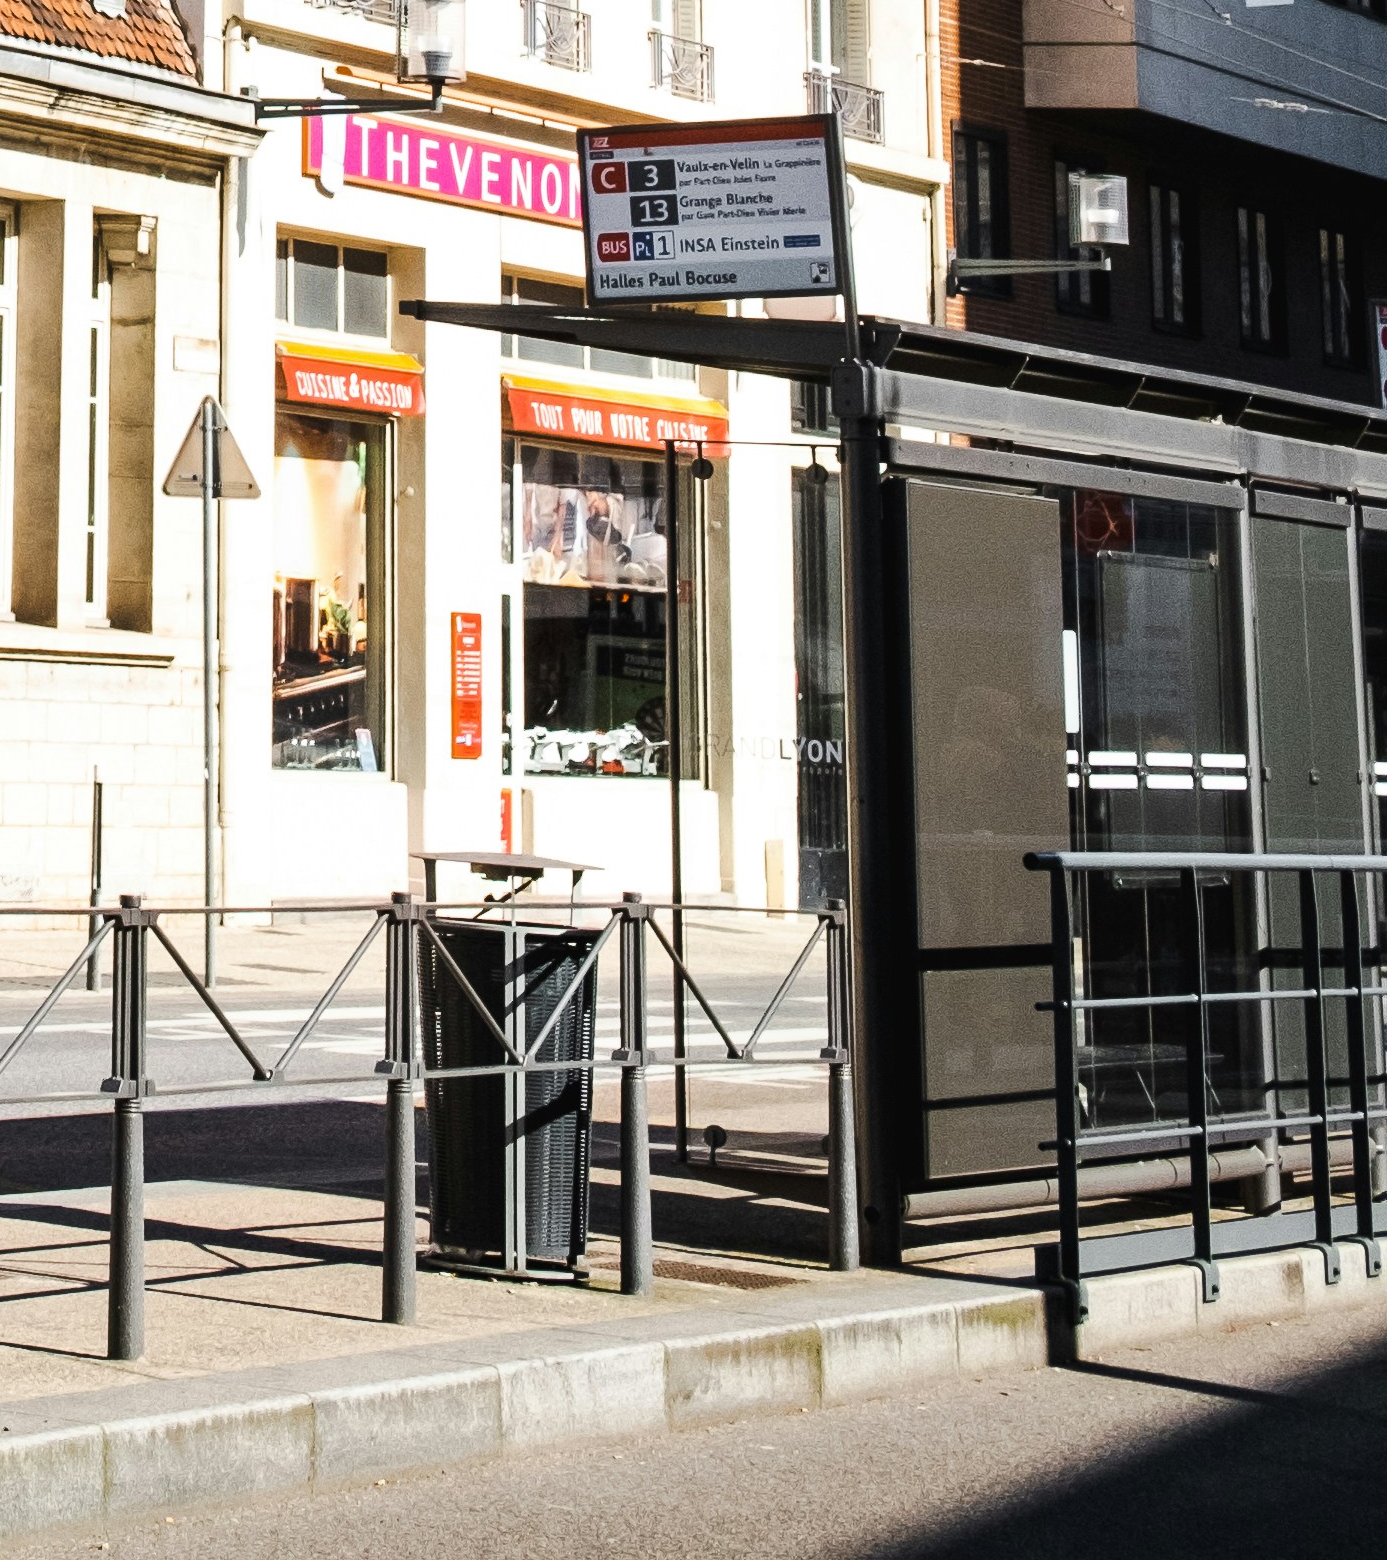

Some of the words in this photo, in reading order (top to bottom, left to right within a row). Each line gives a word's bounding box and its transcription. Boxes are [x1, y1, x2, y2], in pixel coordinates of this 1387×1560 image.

[600, 166, 616, 189] C
[643, 165, 659, 187] 3
[677, 157, 760, 173] Vaulx-en-Velin
[639, 199, 669, 222] 13
[680, 194, 722, 210] Grange
[725, 192, 773, 205] Blanche
[601, 240, 627, 254] BUS
[657, 235, 671, 256] 1
[680, 237, 716, 253] INSA
[721, 234, 780, 252] Einstein
[599, 273, 644, 289] Halles
[649, 271, 681, 287] Paul
[685, 269, 738, 286] Bocuse
[295, 370, 350, 402] CUISINE
[349, 372, 360, 399] &
[360, 378, 413, 409] PASSION
[531, 401, 564, 431] TOUT
[570, 406, 604, 437] POUR
[610, 412, 652, 442] VOTRE
[656, 418, 709, 449] CUISINE
